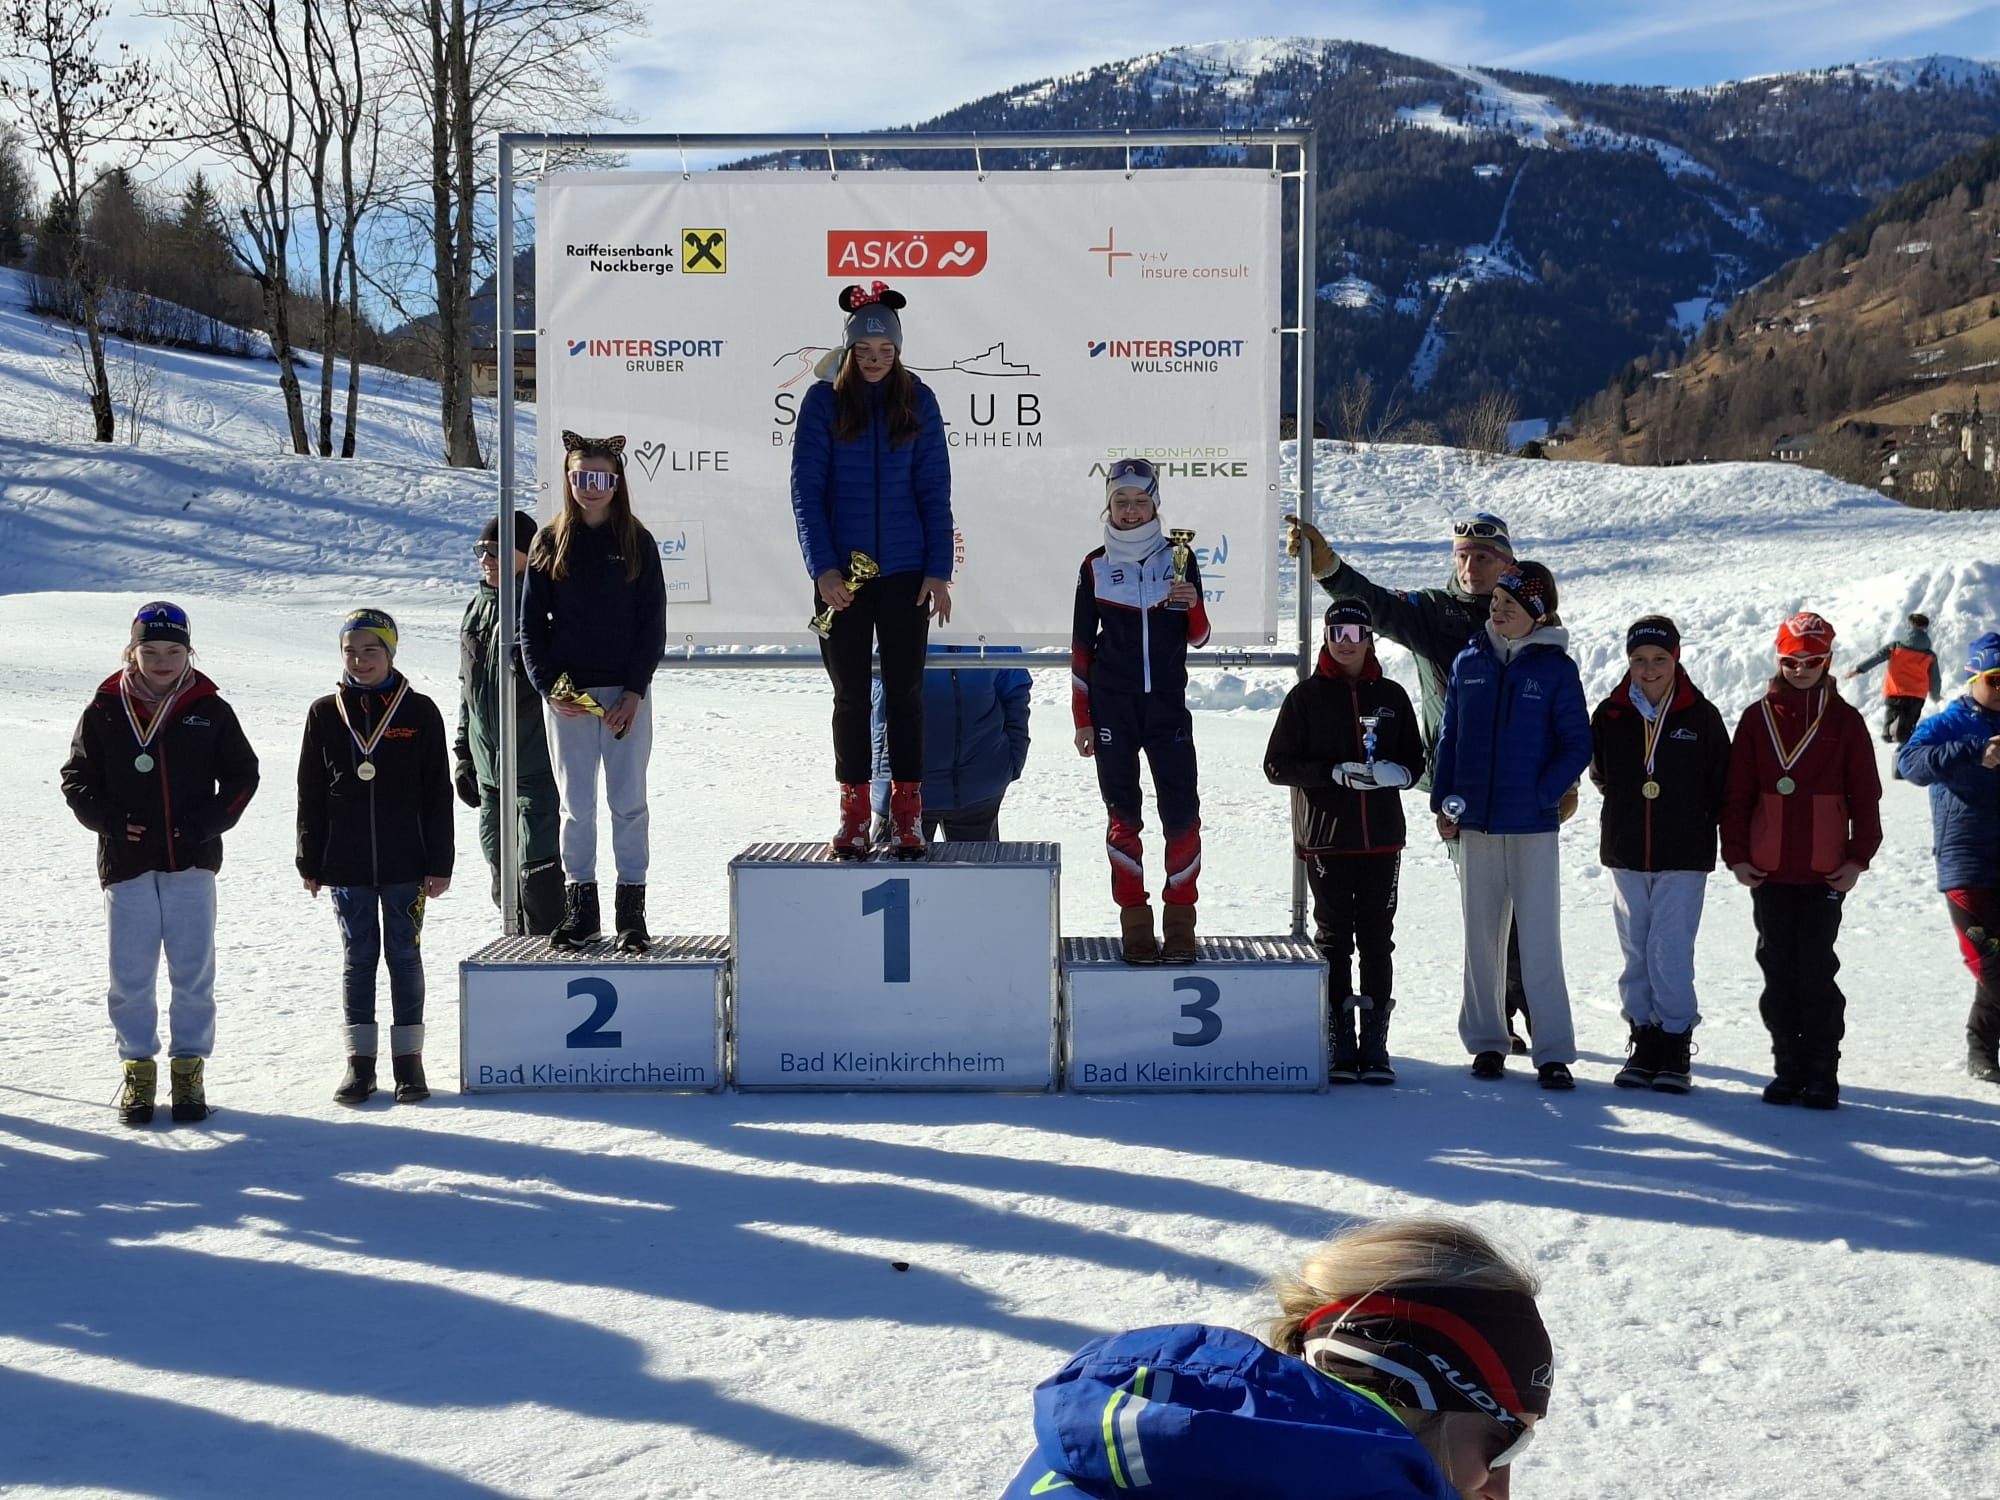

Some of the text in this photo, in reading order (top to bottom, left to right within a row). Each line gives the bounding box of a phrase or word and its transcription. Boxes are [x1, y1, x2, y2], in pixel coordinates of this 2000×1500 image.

[566, 244, 673, 257] Raiffeisenbank
[838, 235, 928, 269] ASKÖ
[590, 260, 673, 275] Nockberge
[1141, 264, 1249, 278] insure consult
[589, 339, 723, 357] INTERSPORT
[1109, 340, 1244, 358] INTERSPORT
[626, 360, 684, 372] GRUBER
[1131, 361, 1218, 372] WULSCHNIG
[672, 451, 729, 471] LIFE
[1107, 447, 1229, 458] ST. LEONHARD
[1088, 462, 1248, 477] ATHEKE
[862, 878, 910, 983] 1
[566, 977, 622, 1048] 2
[1172, 976, 1223, 1047] 3
[780, 1052, 1005, 1072] Bad Kleinkirchheim
[1084, 1061, 1308, 1082] Bad Kleinkirchheim
[479, 1062, 705, 1084] Bad Kleinkirchheim
[1427, 1354, 1516, 1429] RUDY
